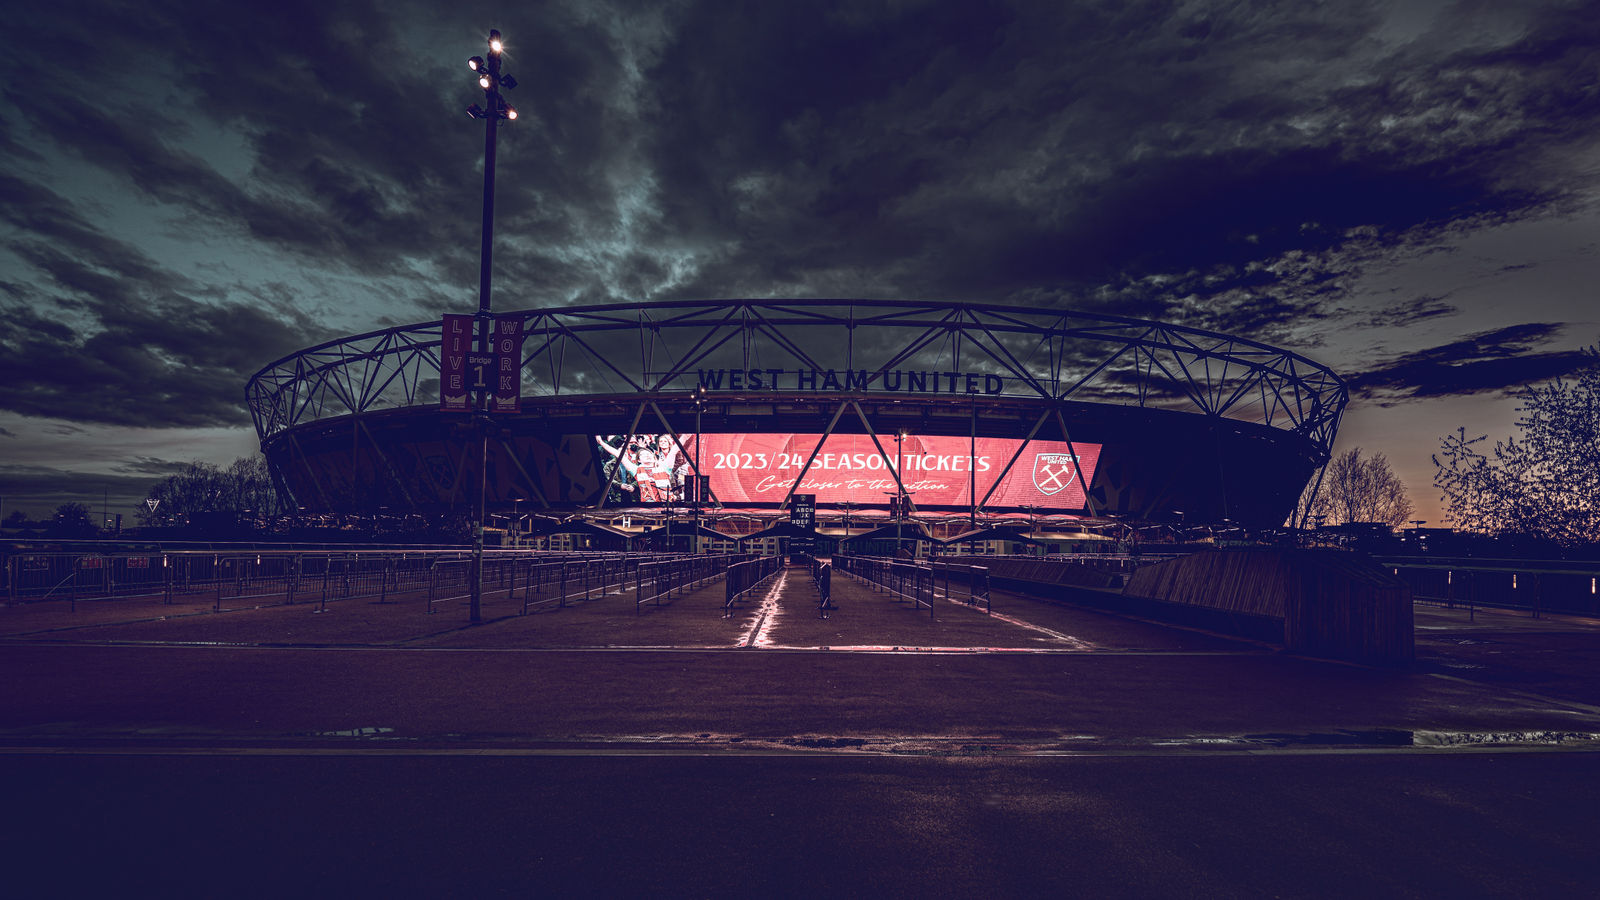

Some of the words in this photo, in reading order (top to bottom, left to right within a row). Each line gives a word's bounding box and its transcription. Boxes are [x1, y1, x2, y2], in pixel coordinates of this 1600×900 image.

[449, 319, 462, 389] LIVE
[469, 356, 492, 365] Bridge
[500, 321, 518, 391] WORK
[473, 365, 486, 388] 1
[698, 368, 784, 391] WEST
[798, 368, 868, 391] HAM
[883, 369, 1003, 395] UNITED
[713, 451, 805, 471] 2023/24
[809, 453, 899, 470] SEASON
[903, 454, 991, 472] TICKETS
[755, 475, 794, 492] Get
[799, 479, 842, 490] closer
[844, 480, 864, 490] to
[867, 479, 898, 490] the
[622, 516, 631, 529] H
